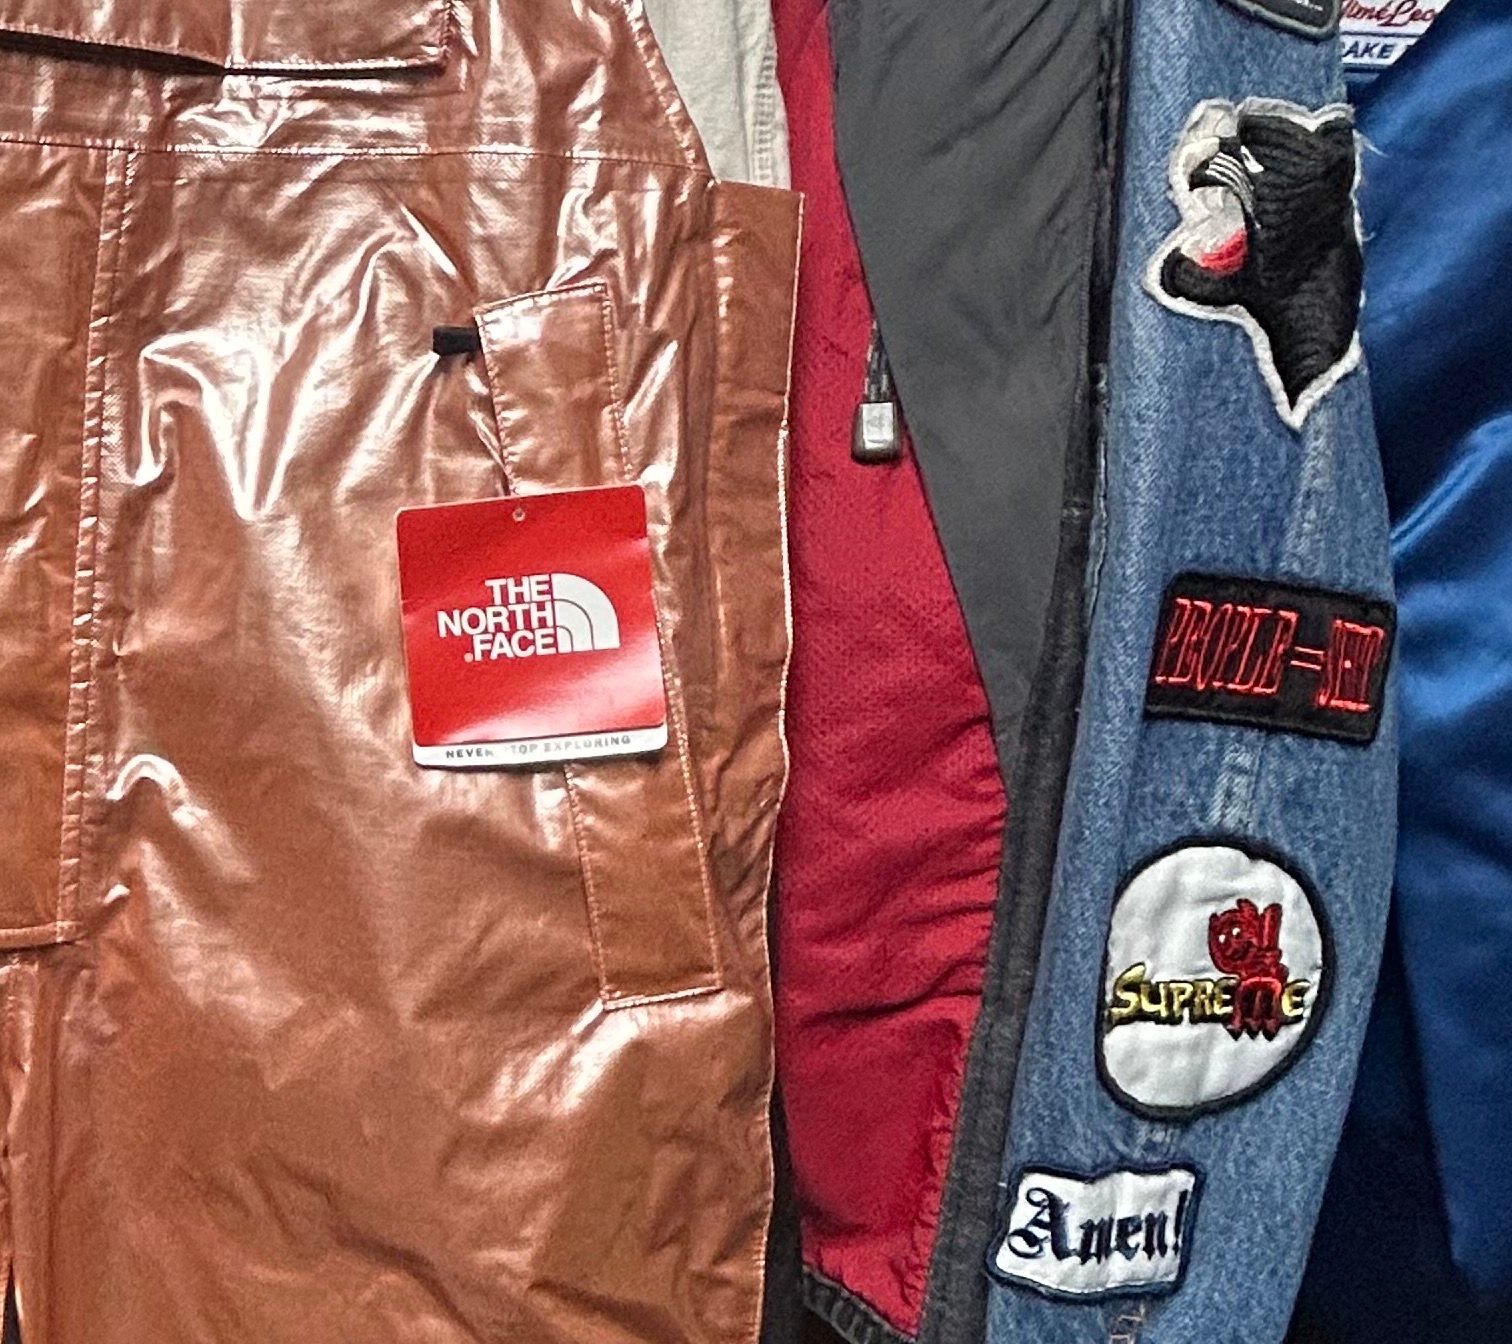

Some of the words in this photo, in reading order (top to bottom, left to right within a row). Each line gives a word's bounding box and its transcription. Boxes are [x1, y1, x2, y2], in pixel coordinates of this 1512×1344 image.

[1342, 41, 1396, 59] AKE
[485, 574, 552, 605] THE
[437, 601, 554, 638] NORTH
[473, 628, 558, 661] FACE
[1008, 1187, 1189, 1266] Amen!
